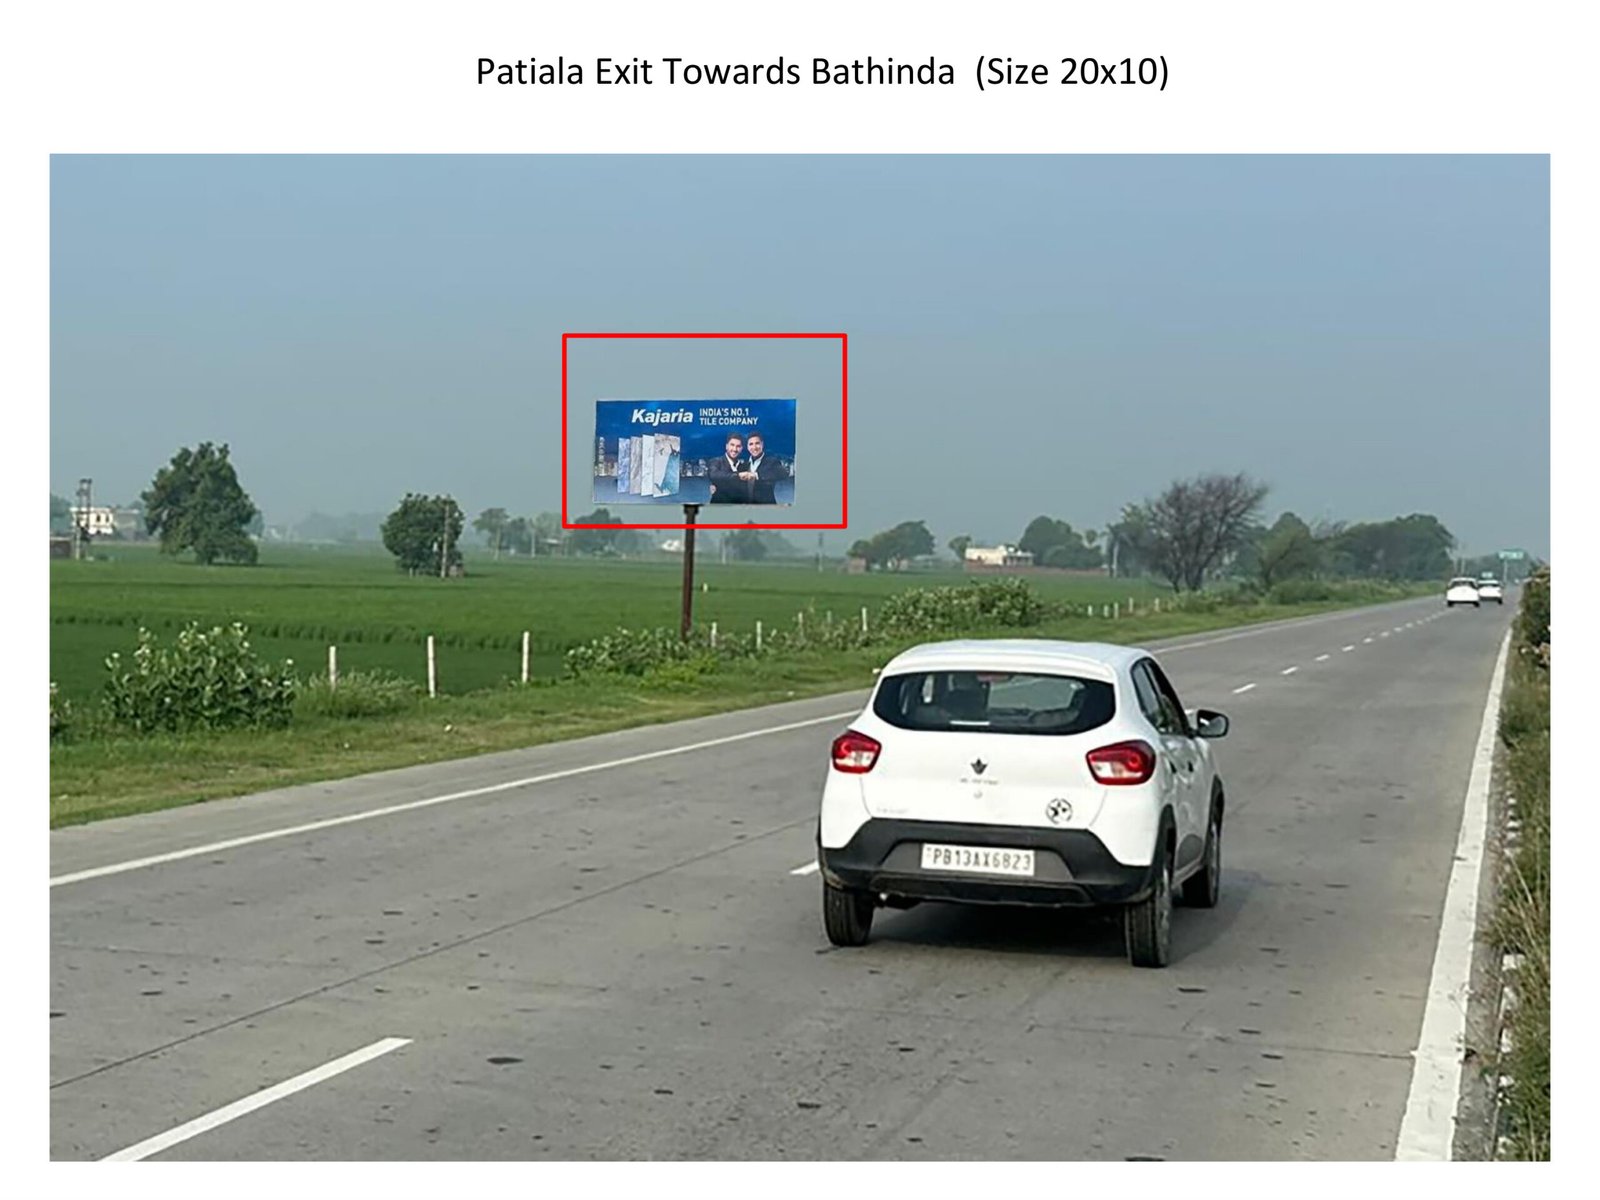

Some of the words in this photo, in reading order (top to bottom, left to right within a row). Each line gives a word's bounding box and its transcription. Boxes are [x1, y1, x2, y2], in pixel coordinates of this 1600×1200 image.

[699, 408, 729, 417] INDIA'S
[730, 408, 749, 416] NO.1
[631, 408, 694, 427] Kajaria
[699, 417, 717, 426] TILE
[718, 417, 759, 426] COMPANY
